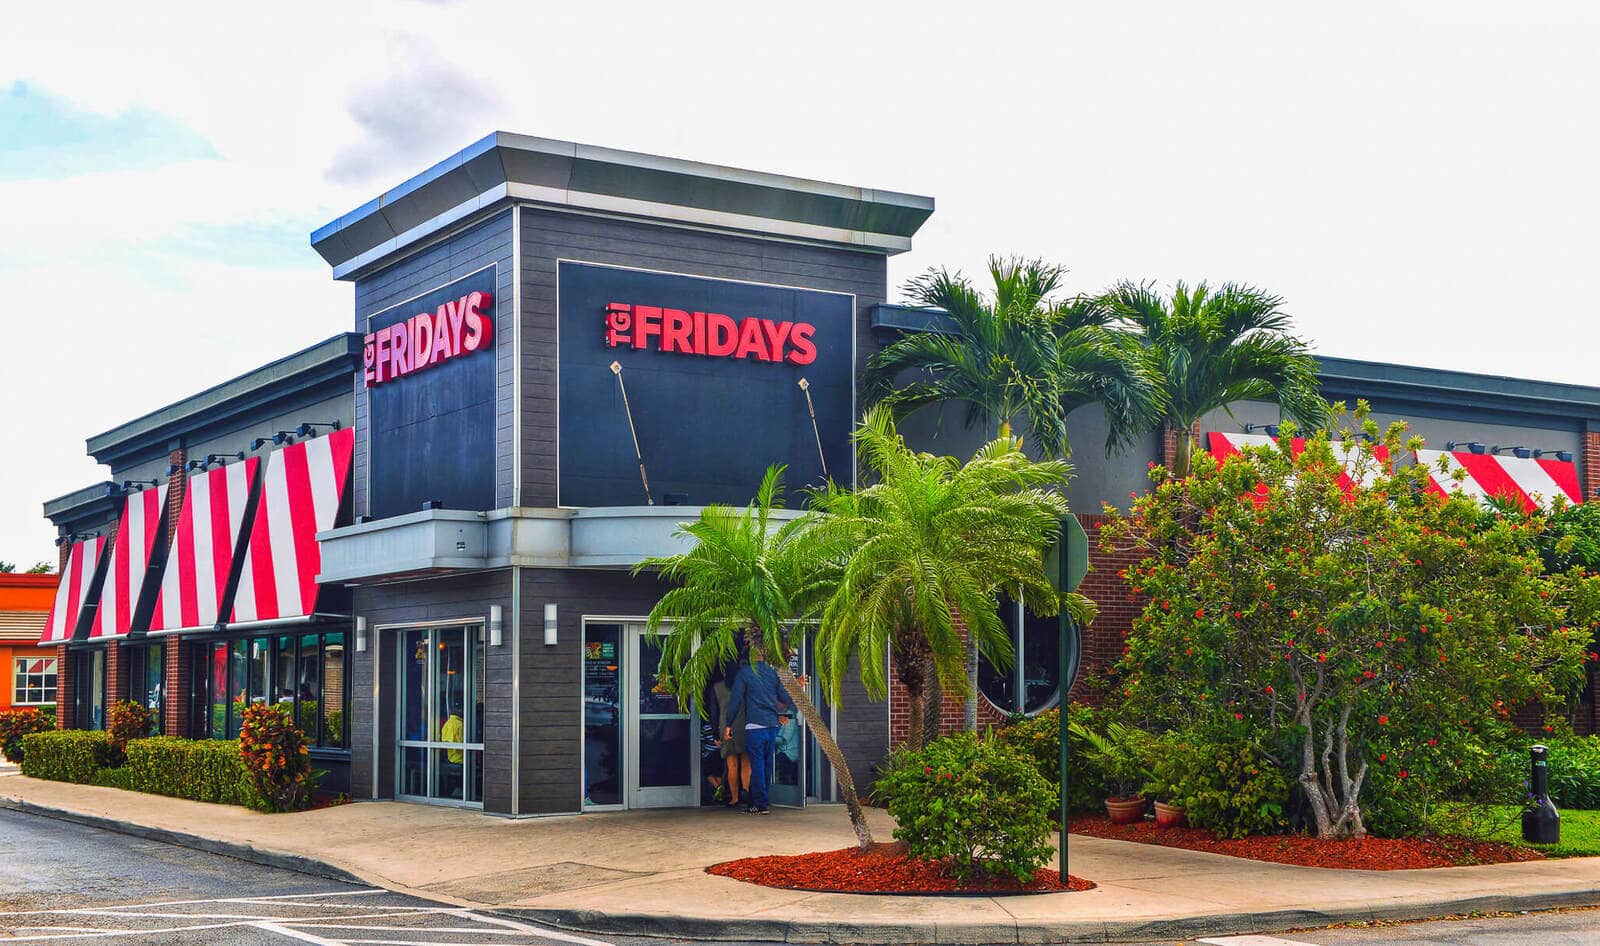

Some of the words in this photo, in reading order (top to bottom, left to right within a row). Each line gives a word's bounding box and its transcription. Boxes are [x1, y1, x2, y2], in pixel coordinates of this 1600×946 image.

[364, 333, 376, 388] TGI
[375, 291, 491, 383] FRIDAYS
[607, 302, 631, 347] TGI
[632, 304, 817, 365] FRIDAYS
